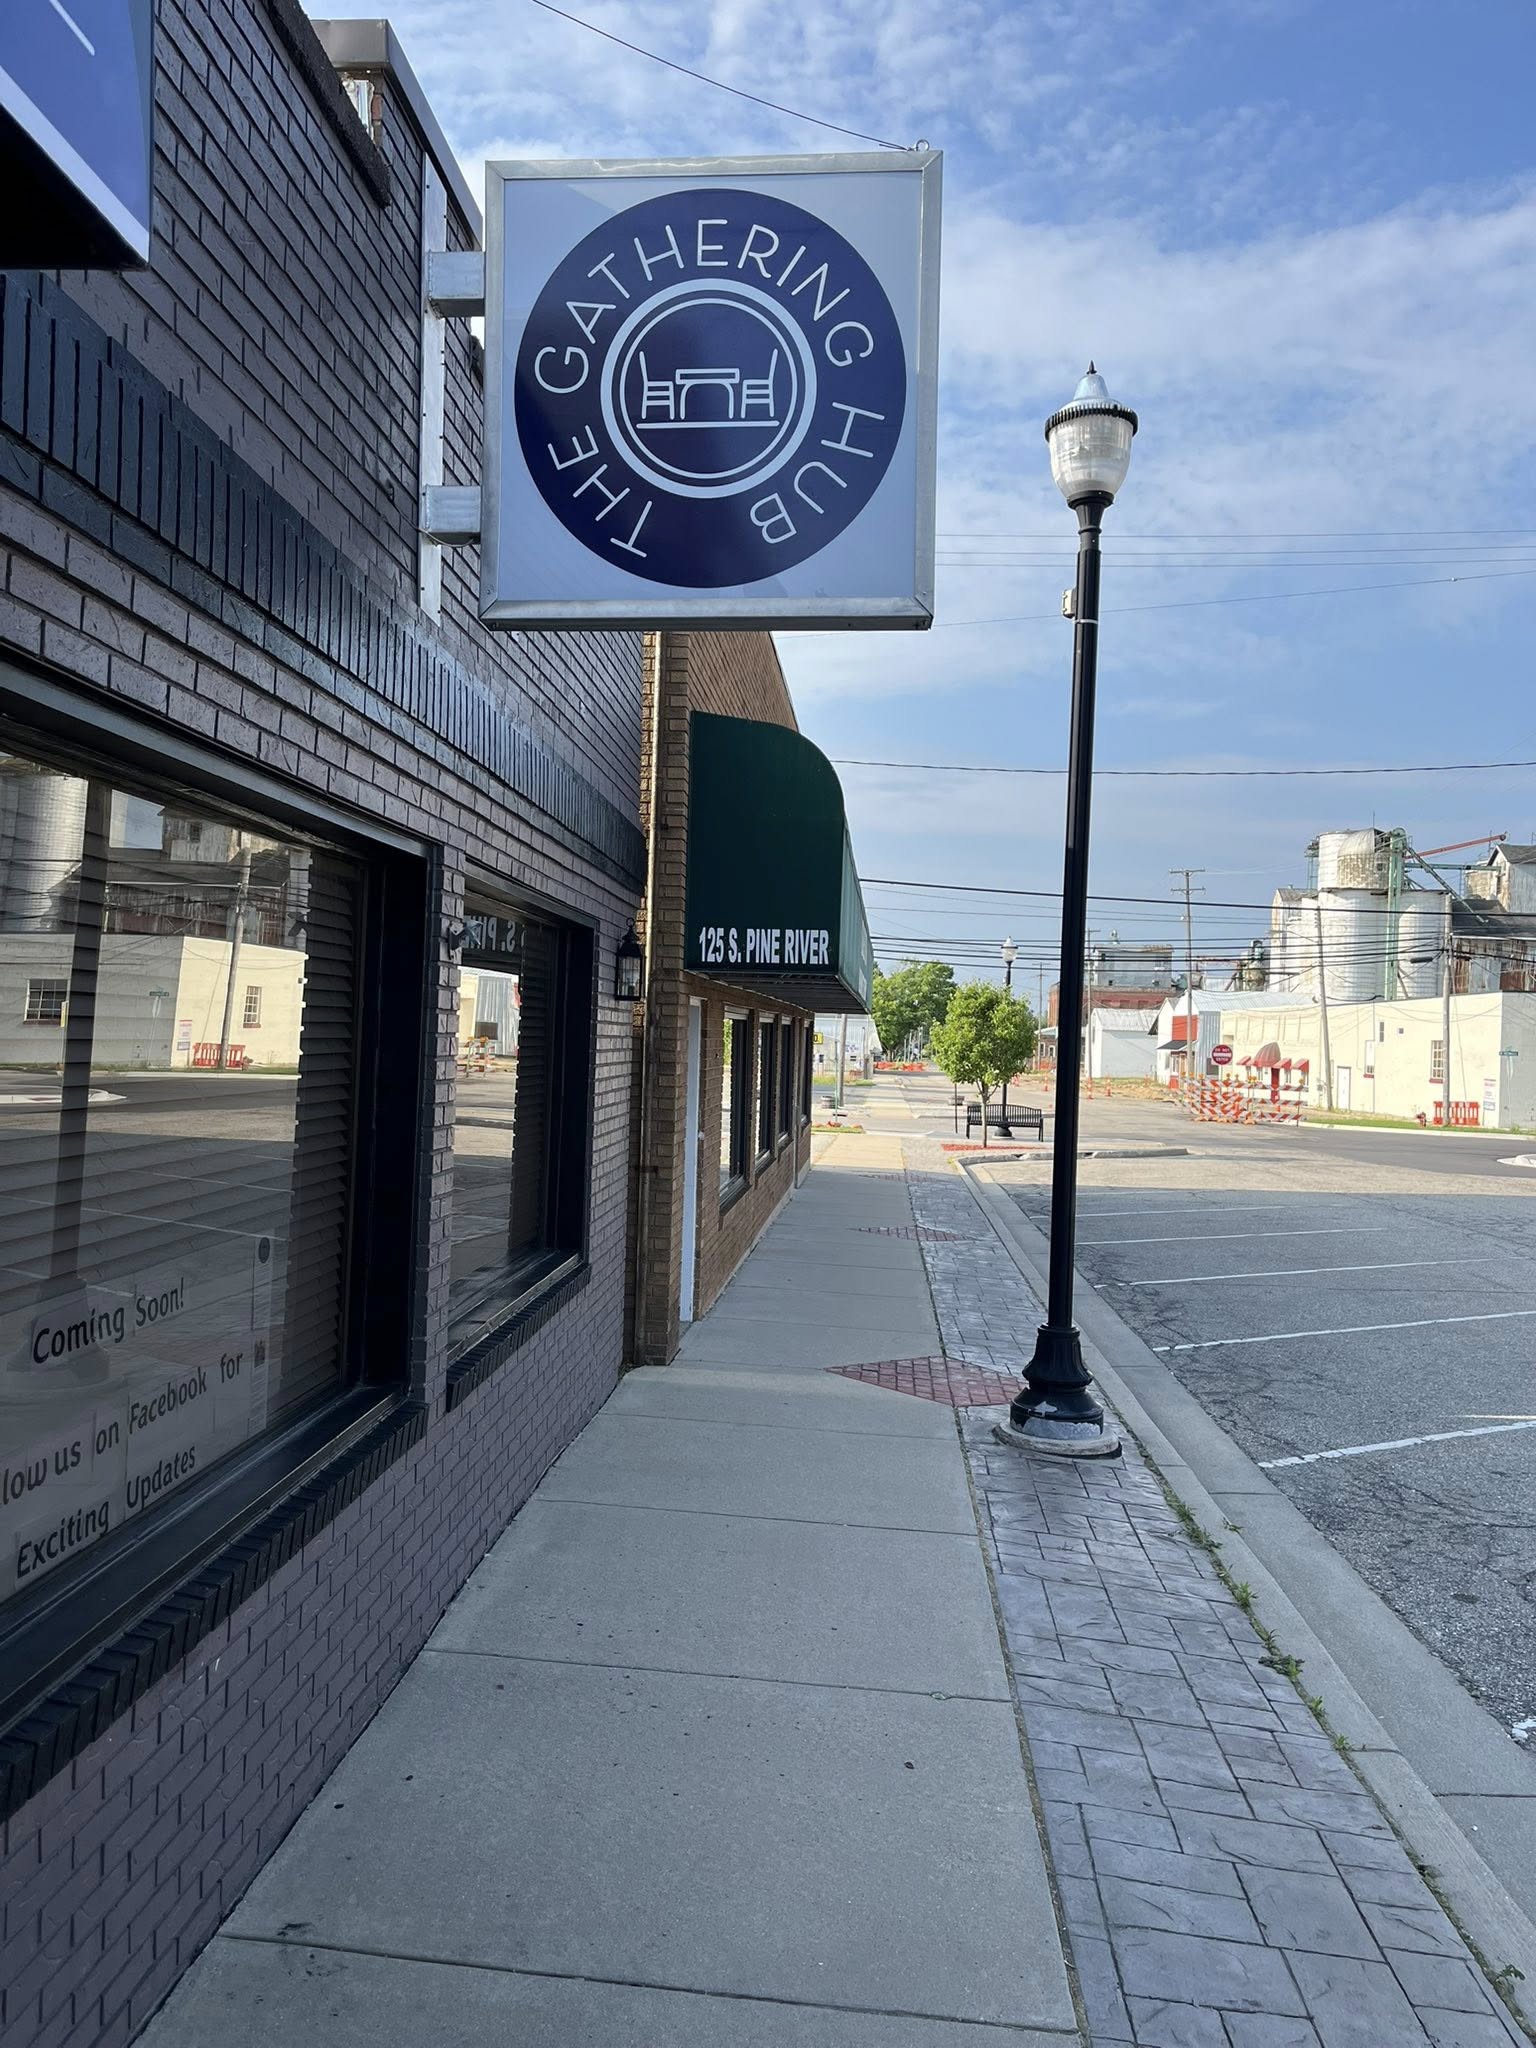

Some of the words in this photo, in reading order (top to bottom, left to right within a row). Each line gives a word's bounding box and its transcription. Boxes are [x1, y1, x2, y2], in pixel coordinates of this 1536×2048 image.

[534, 218, 875, 394] GATHERING
[547, 424, 653, 558] THE
[749, 401, 886, 544] HUB
[699, 926, 725, 963] 125
[728, 927, 742, 963] S.
[746, 928, 781, 964] PINE
[784, 928, 829, 965] RIVER
[33, 1306, 125, 1364] Coming
[135, 1277, 185, 1328] Soon!
[54, 1441, 81, 1476] us
[95, 1421, 119, 1455] on
[128, 1364, 208, 1435] Facebook
[220, 1352, 244, 1385] for
[17, 1501, 110, 1579] Exciting
[126, 1445, 196, 1510] Updates
